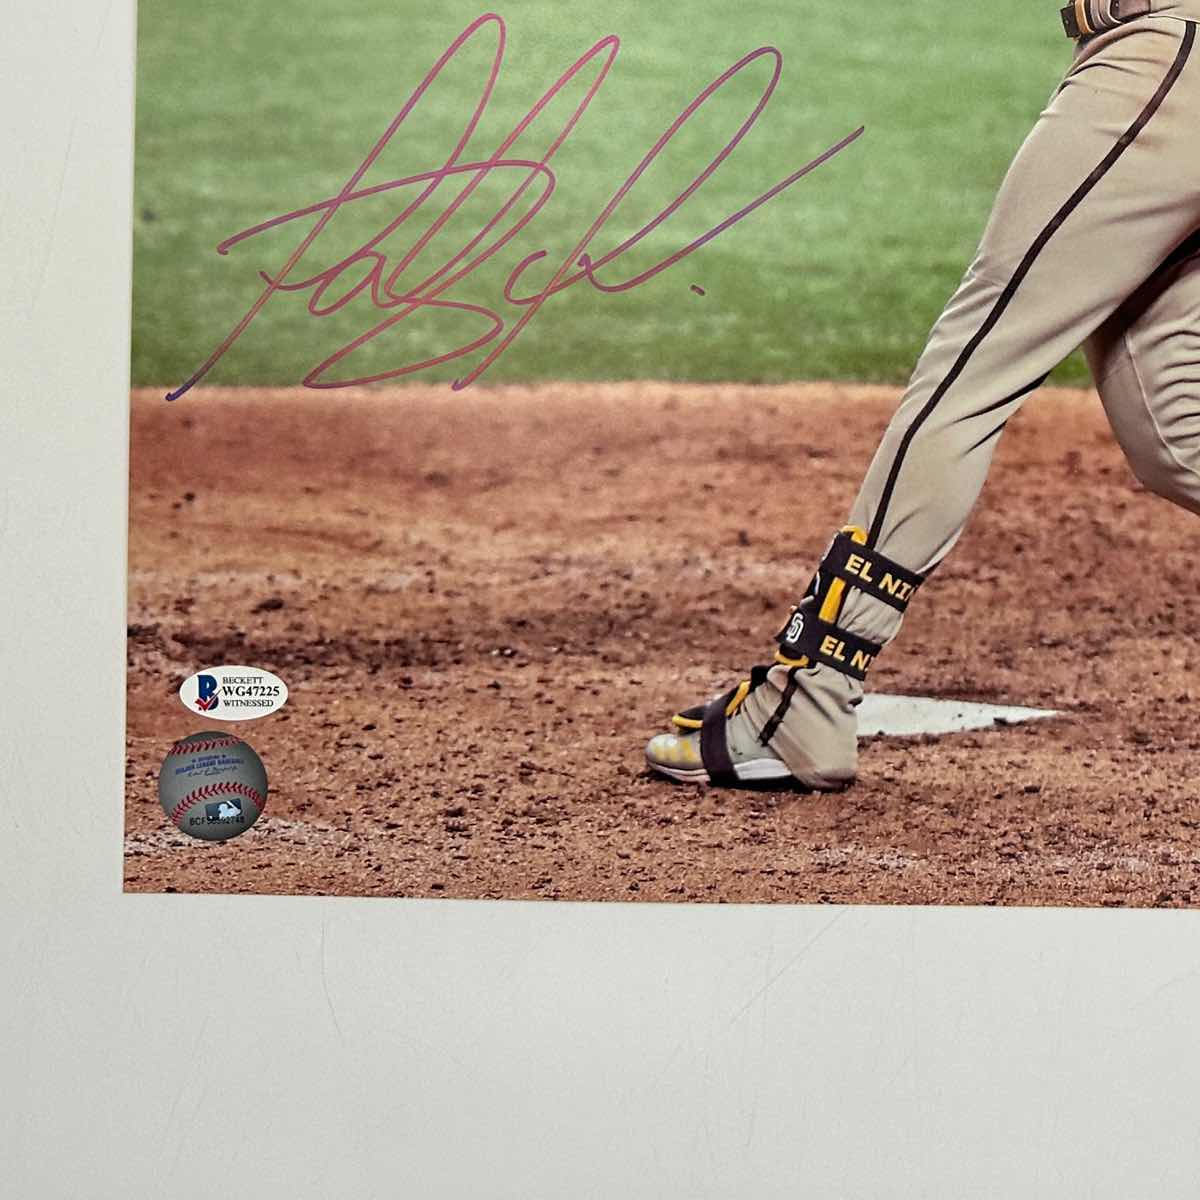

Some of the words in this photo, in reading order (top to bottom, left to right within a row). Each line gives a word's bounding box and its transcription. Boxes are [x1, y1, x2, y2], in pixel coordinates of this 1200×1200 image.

[844, 553, 873, 583] EL
[878, 572, 917, 602] NI
[819, 635, 846, 662] EL
[850, 650, 875, 672] N
[222, 676, 264, 685] BECKETT
[222, 686, 280, 697] WG47225
[223, 699, 274, 707] WITNESSED
